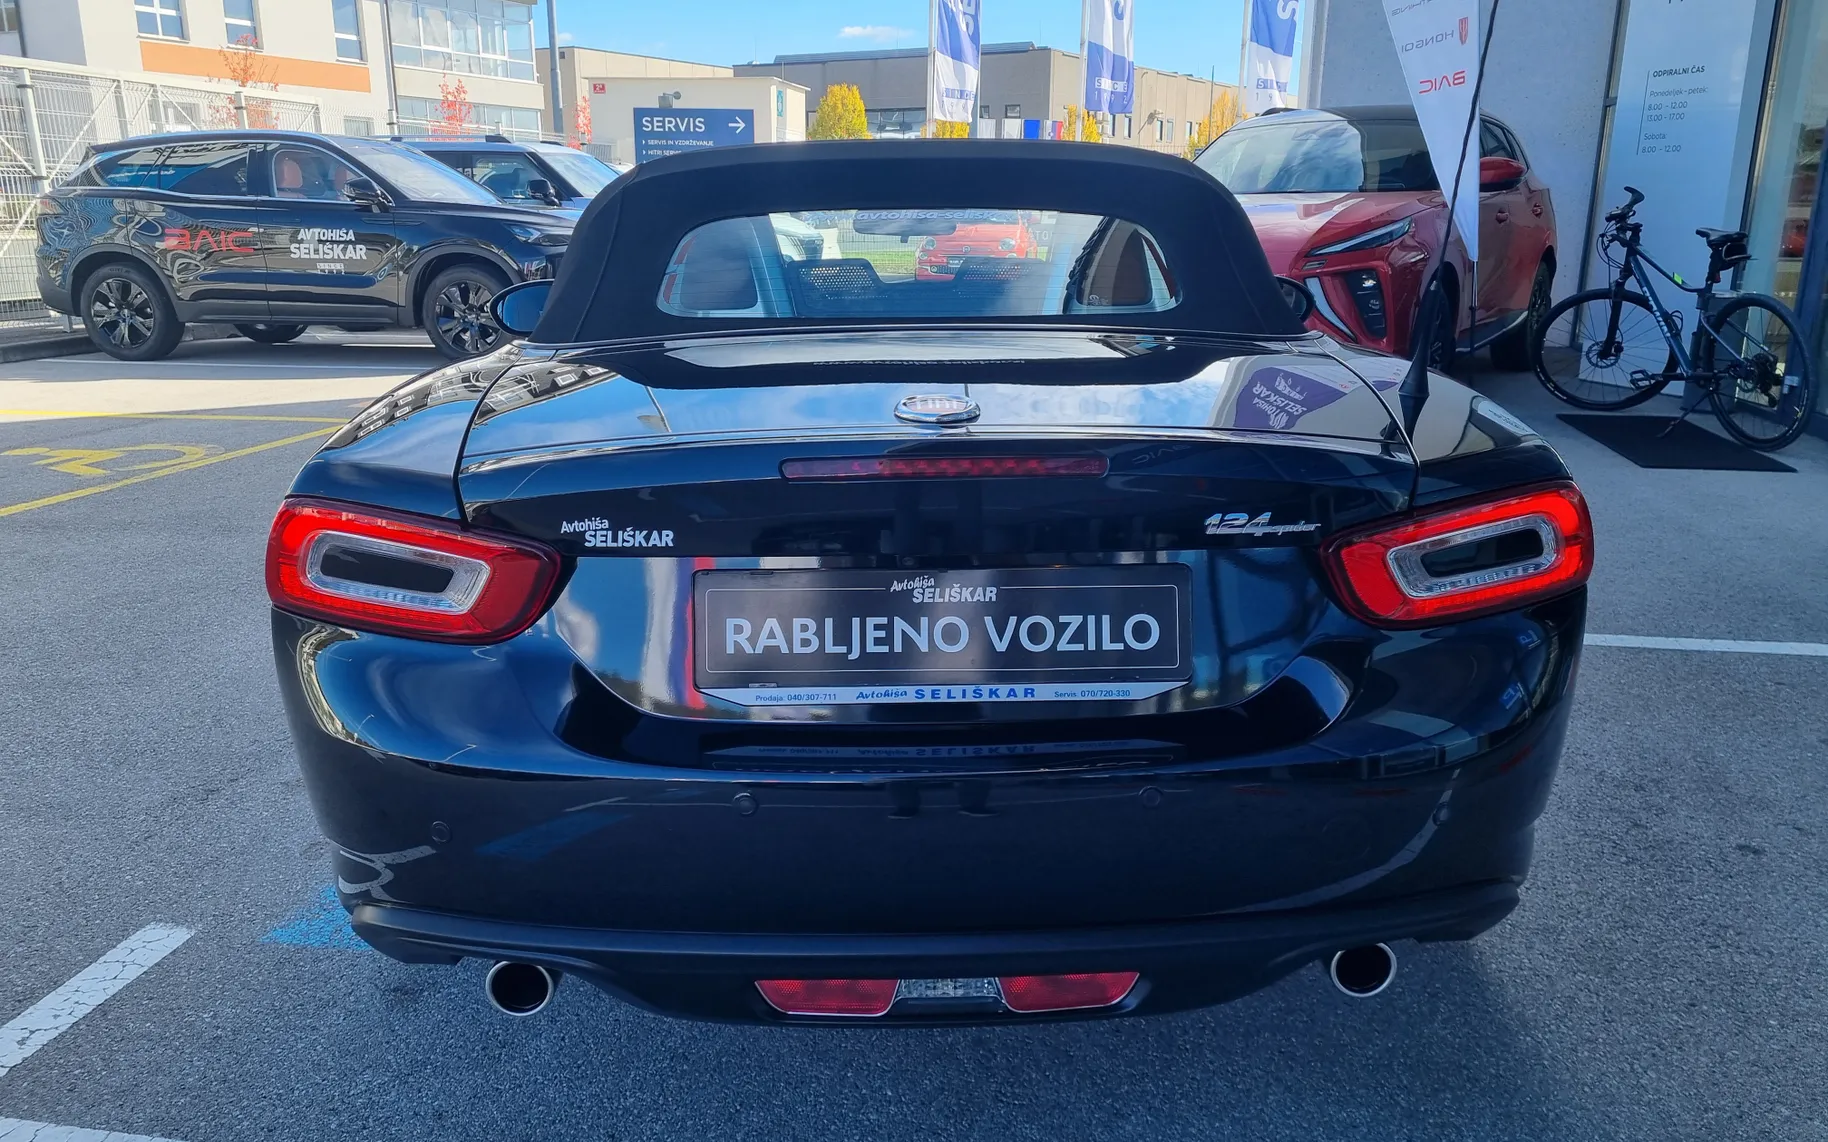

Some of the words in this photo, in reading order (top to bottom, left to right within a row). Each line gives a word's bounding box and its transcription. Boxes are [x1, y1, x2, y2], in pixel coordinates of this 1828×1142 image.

[1652, 68, 1689, 78] ODPIRALNI
[1691, 65, 1705, 73] ČAS
[1648, 103, 1662, 111] 8.00
[1671, 101, 1688, 109] 12.00
[642, 117, 706, 132] SERVIS
[1647, 114, 1662, 122] 13.00
[1669, 112, 1685, 120] 17.00
[675, 139, 714, 147] VZDRŽEVANJE
[1644, 132, 1667, 140] Sobota:
[1642, 145, 1657, 153] 8.00
[1665, 144, 1682, 153] 12.00
[164, 228, 255, 253] BAIC
[290, 241, 367, 260] SELIŠKAR
[1204, 512, 1272, 536] 124
[584, 527, 674, 547] SELIŠKAR
[890, 575, 935, 592] Avtohiša
[912, 583, 998, 603] SELIŠKAR
[724, 615, 970, 661] RABLJENO
[984, 612, 1161, 653] VOZILO
[787, 693, 837, 701] 040/307-711
[855, 688, 908, 700] Avtohiša
[914, 685, 1036, 700] SELIŠKAR
[1080, 689, 1131, 698] 070/720-330
